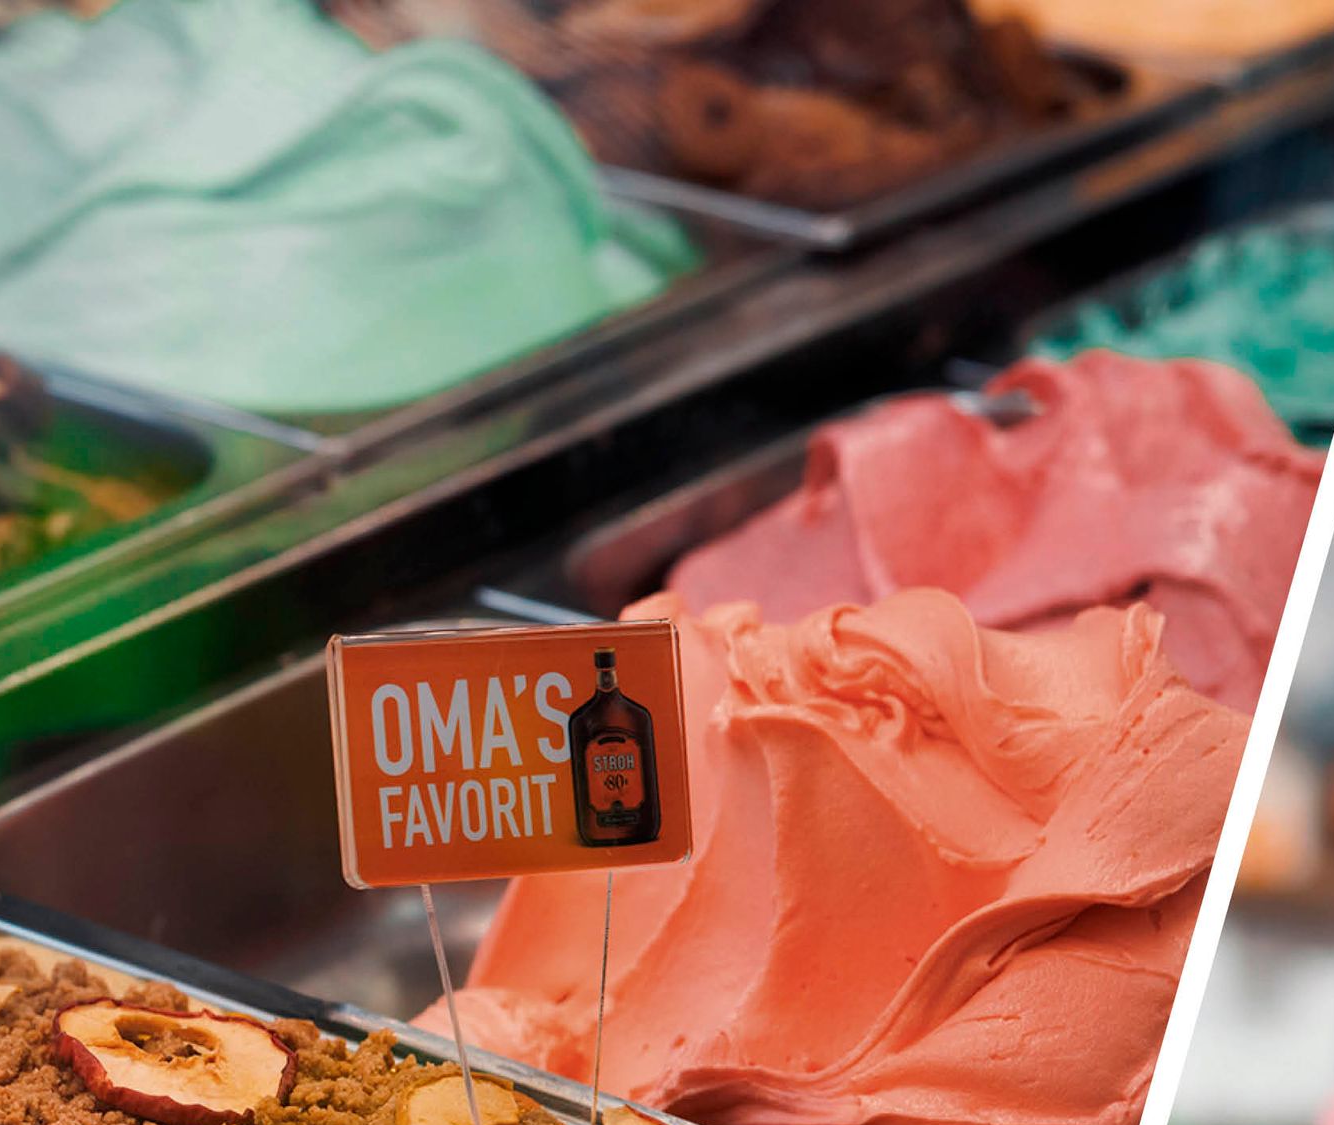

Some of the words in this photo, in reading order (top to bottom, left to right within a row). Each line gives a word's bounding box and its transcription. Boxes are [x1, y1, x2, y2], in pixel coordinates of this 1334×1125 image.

[371, 671, 573, 777] OMA'S
[593, 754, 635, 773] STROH
[379, 774, 557, 849] FAVORIT
